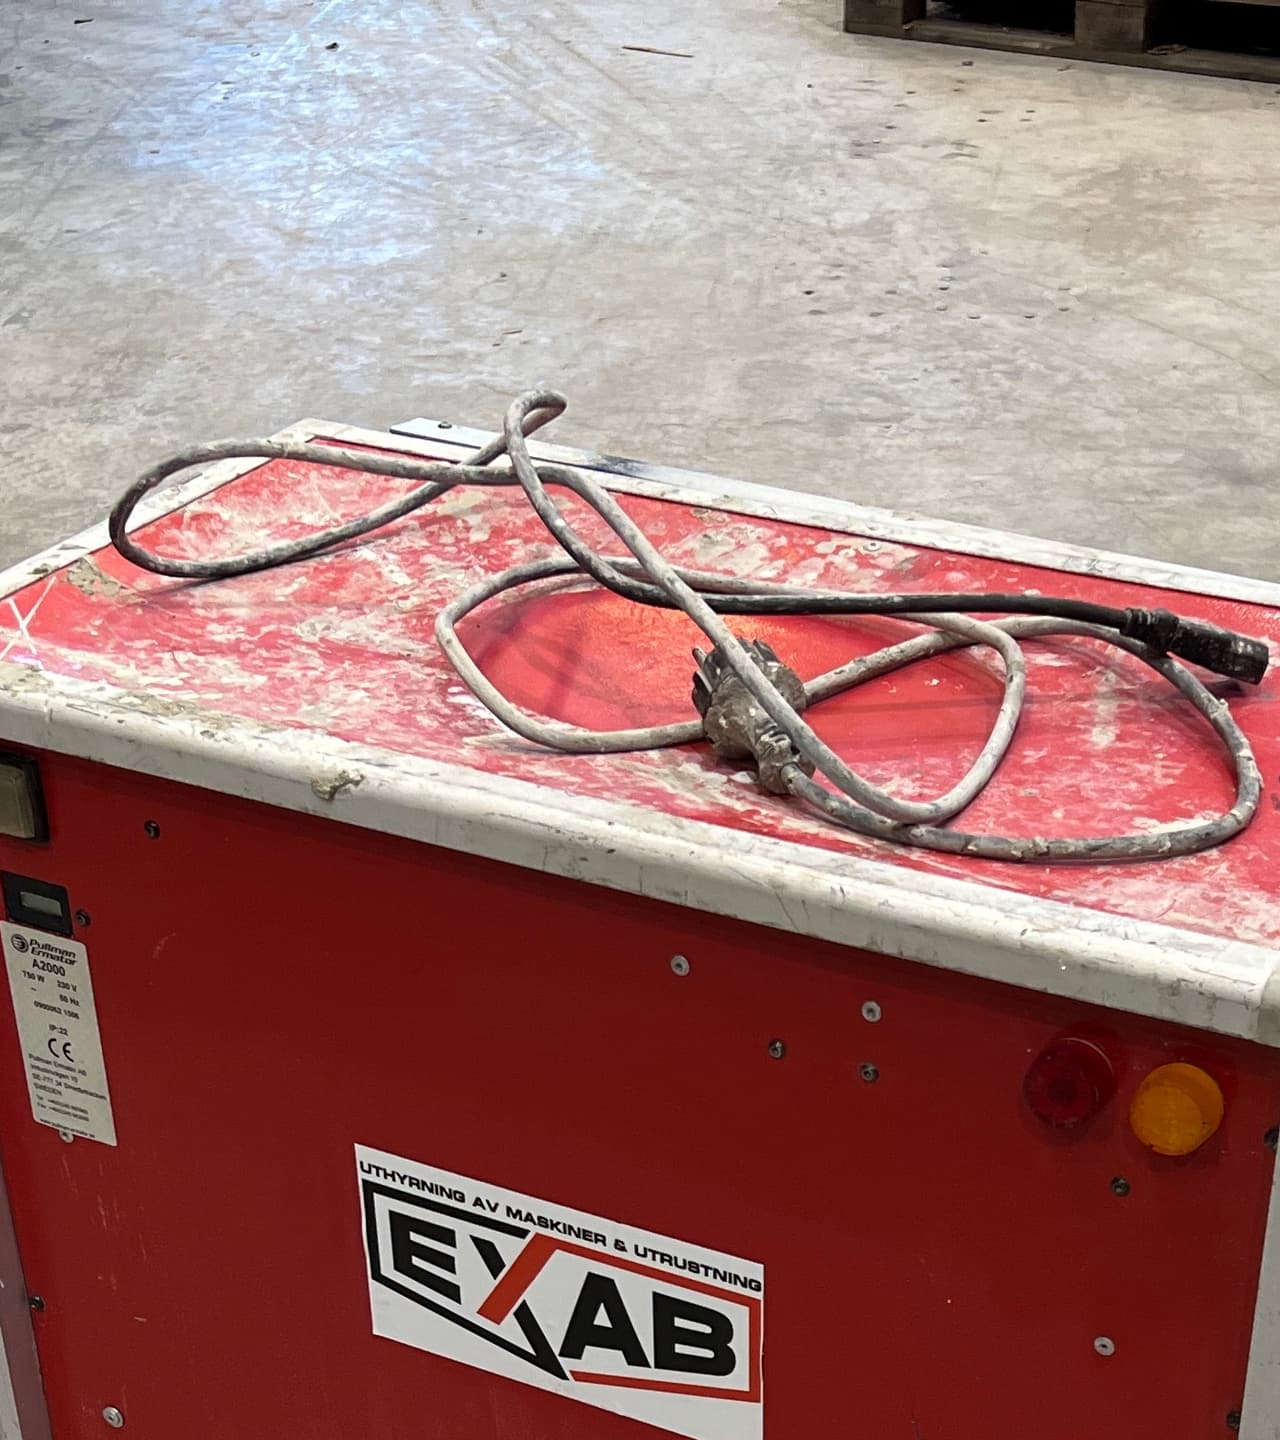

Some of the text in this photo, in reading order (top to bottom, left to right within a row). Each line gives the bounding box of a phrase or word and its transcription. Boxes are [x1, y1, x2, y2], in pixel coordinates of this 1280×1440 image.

[29, 938, 77, 959] Pullman
[30, 947, 78, 965] Ermator
[32, 958, 66, 977] A2000
[48, 1038, 74, 1063] CE
[359, 1160, 763, 1293] UTHYRNING AV MASKINER & UTRUSTNING
[388, 1209, 737, 1380] EXAB
